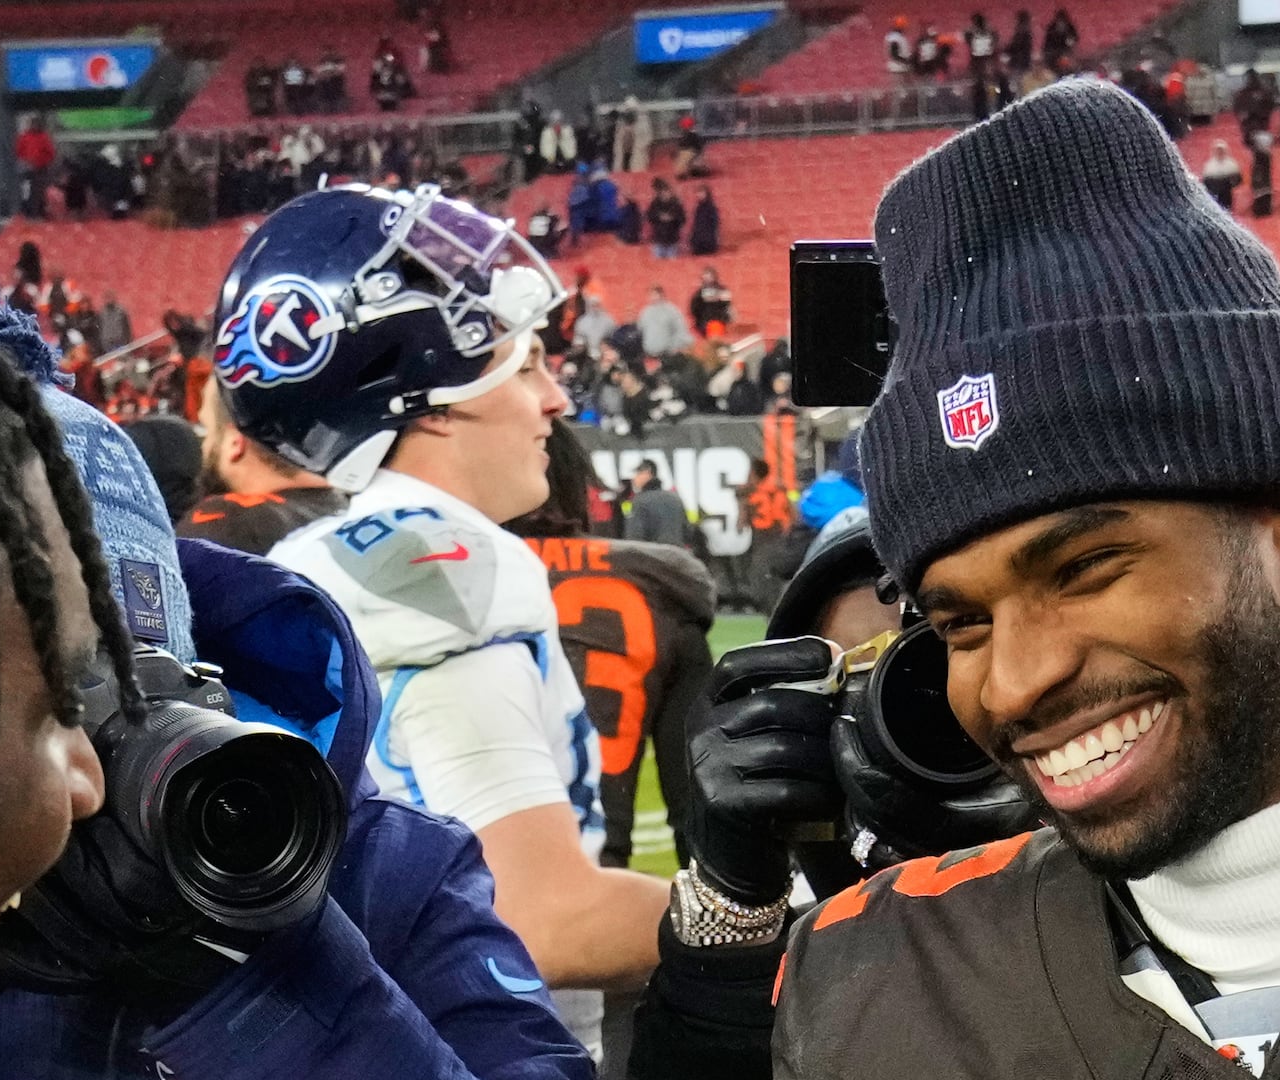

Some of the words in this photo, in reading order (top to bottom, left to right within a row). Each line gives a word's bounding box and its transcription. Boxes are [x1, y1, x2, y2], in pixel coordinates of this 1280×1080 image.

[948, 401, 991, 438] NFL
[135, 615, 166, 630] TITANS
[206, 692, 224, 704] EOS
